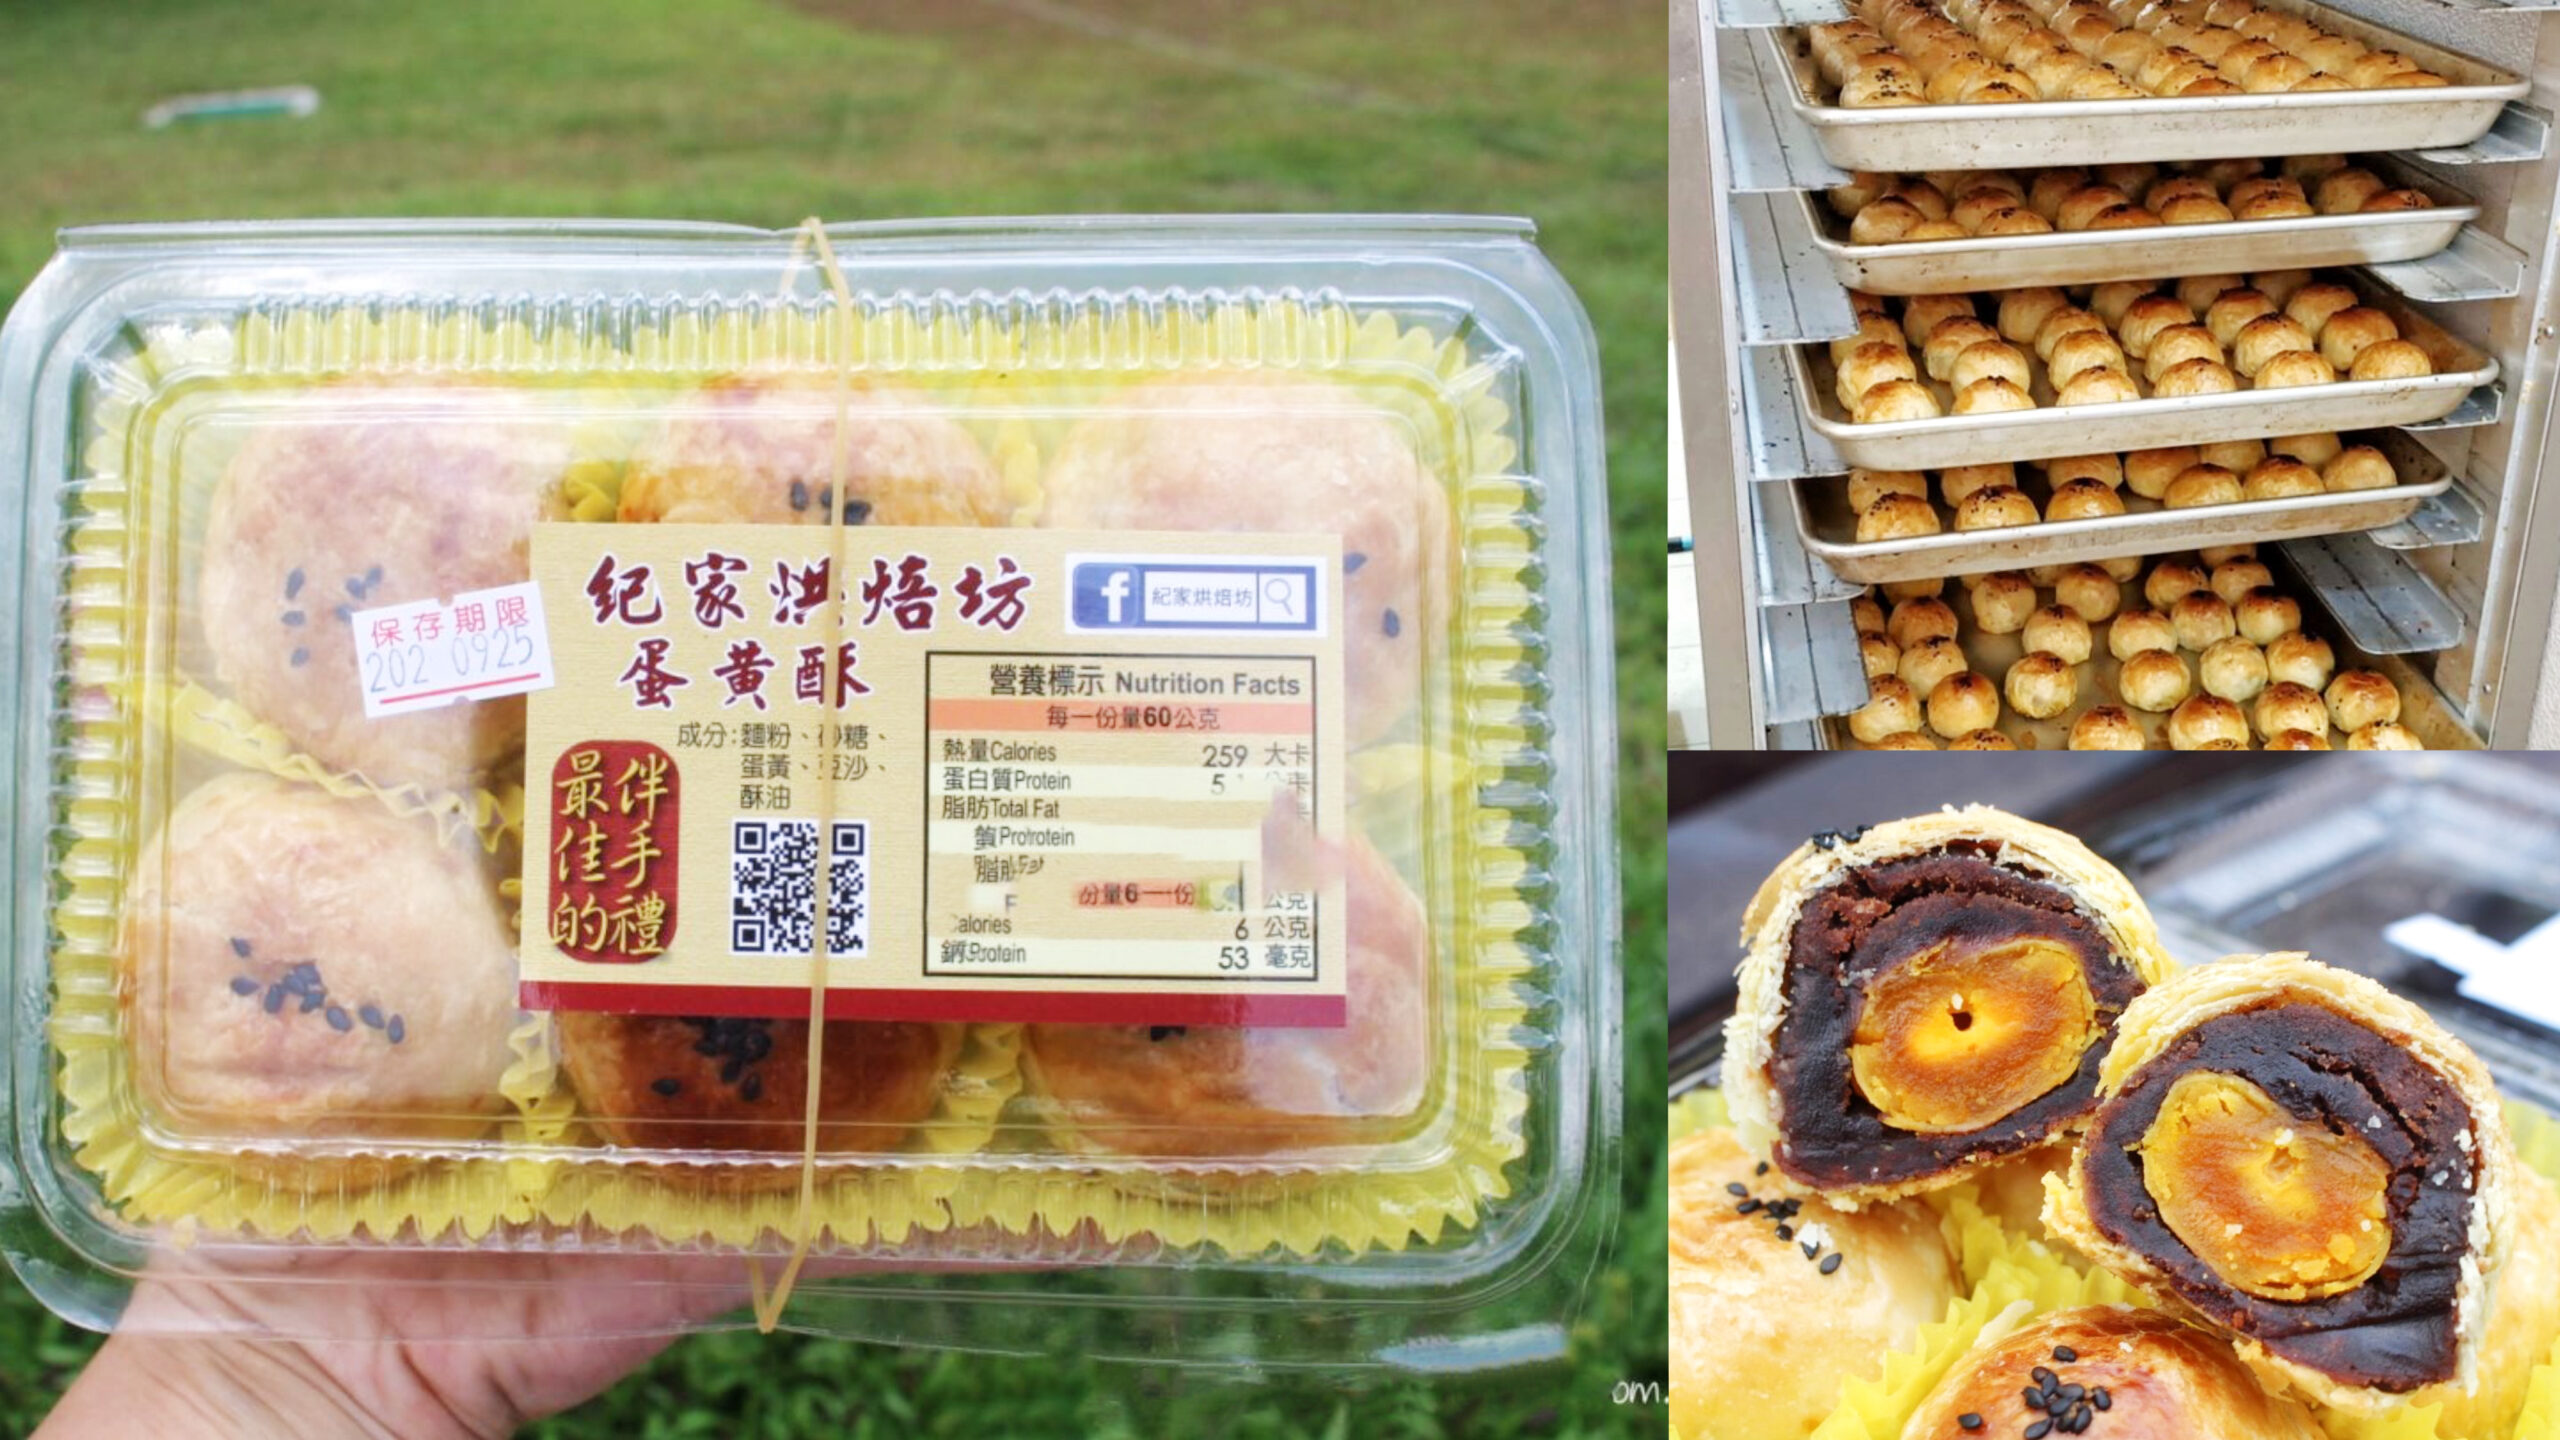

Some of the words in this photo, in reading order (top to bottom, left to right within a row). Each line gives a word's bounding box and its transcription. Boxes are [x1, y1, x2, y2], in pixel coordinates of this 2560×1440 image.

[1151, 586, 1253, 608] 紀家烘焙坊
[371, 596, 529, 649] 保存期限
[990, 664, 1105, 697] 營養標示
[1115, 672, 1224, 695] Nutrition
[1234, 673, 1300, 696] Facts
[1046, 706, 1221, 731] 每一份量60公克
[1202, 744, 1249, 768] 259
[1264, 741, 1311, 766] 大卡
[740, 784, 791, 810] 酥油
[1032, 797, 1060, 819] Fat
[1234, 918, 1249, 940] 6
[1264, 915, 1311, 940] 公克
[1218, 946, 1250, 969] 53
[1264, 943, 1312, 969] 毫克
